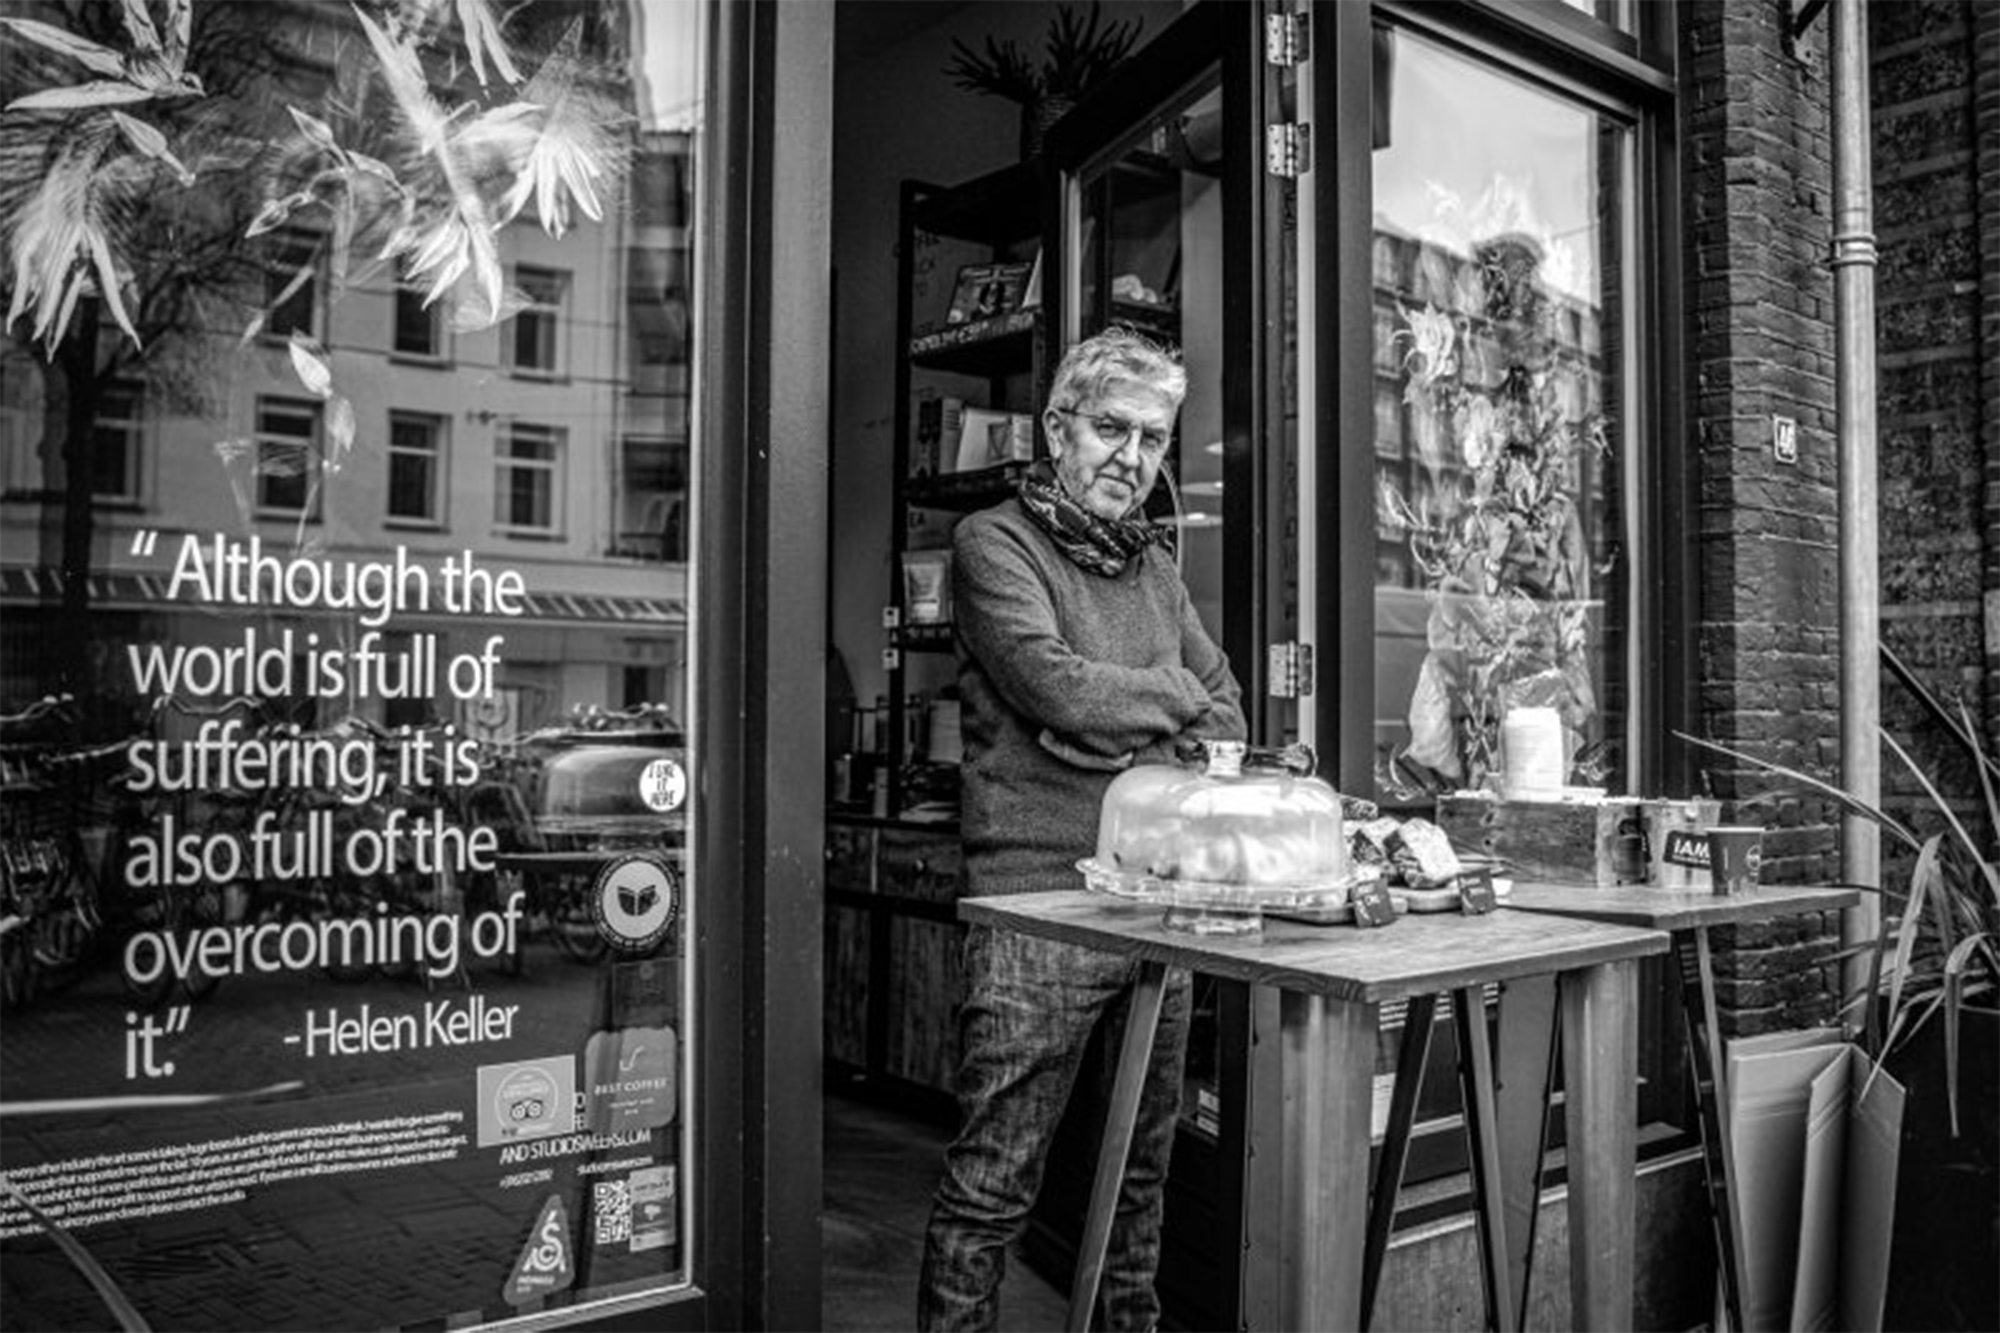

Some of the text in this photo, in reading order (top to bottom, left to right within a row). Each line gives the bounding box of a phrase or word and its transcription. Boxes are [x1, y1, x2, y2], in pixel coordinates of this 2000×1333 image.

[167, 535, 429, 626] Although
[441, 549, 525, 616] the
[128, 630, 502, 698] world is full of
[126, 721, 478, 804] suffering, it is
[125, 808, 498, 887] also full of the
[125, 902, 458, 983] overcoming
[471, 892, 525, 955] of
[126, 1005, 191, 1078] it.”
[424, 995, 518, 1048] Keller
[594, 1077, 668, 1096] BEST COFFEE
[500, 1145, 529, 1165] AND
